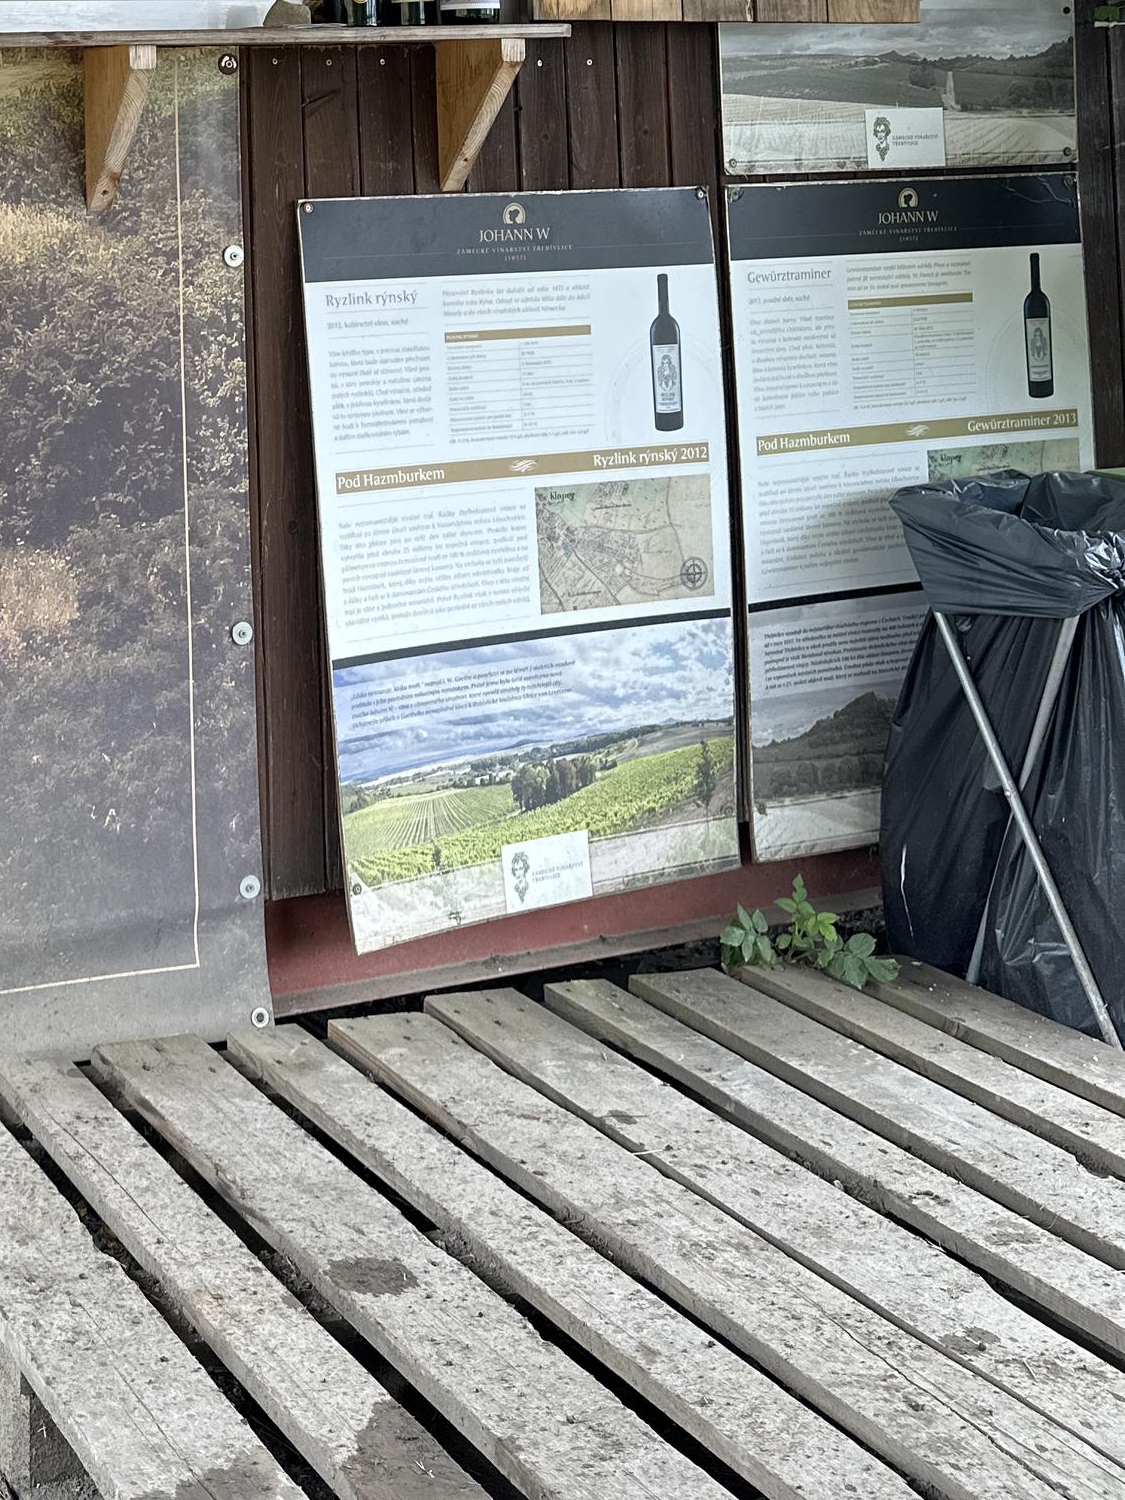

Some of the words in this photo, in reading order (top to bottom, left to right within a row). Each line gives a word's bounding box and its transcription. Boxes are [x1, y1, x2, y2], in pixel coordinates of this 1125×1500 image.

[878, 212, 925, 225] JOHANN
[927, 210, 939, 222] W
[479, 228, 533, 243] JOHANN
[536, 227, 551, 241] W
[747, 267, 832, 285] Gewürztraminer
[325, 291, 373, 309] Ryzlink
[375, 289, 419, 307] rýnský
[967, 414, 1051, 433] Gewürztraminer
[1052, 412, 1077, 426] 2013
[758, 438, 778, 451] Pod
[779, 431, 851, 450] Hazmburkem
[593, 452, 638, 469] Ryzlink
[638, 448, 678, 466] rýnský
[680, 446, 708, 462] 2012
[337, 475, 361, 491] Pod
[364, 466, 445, 488] Hazmburkem
